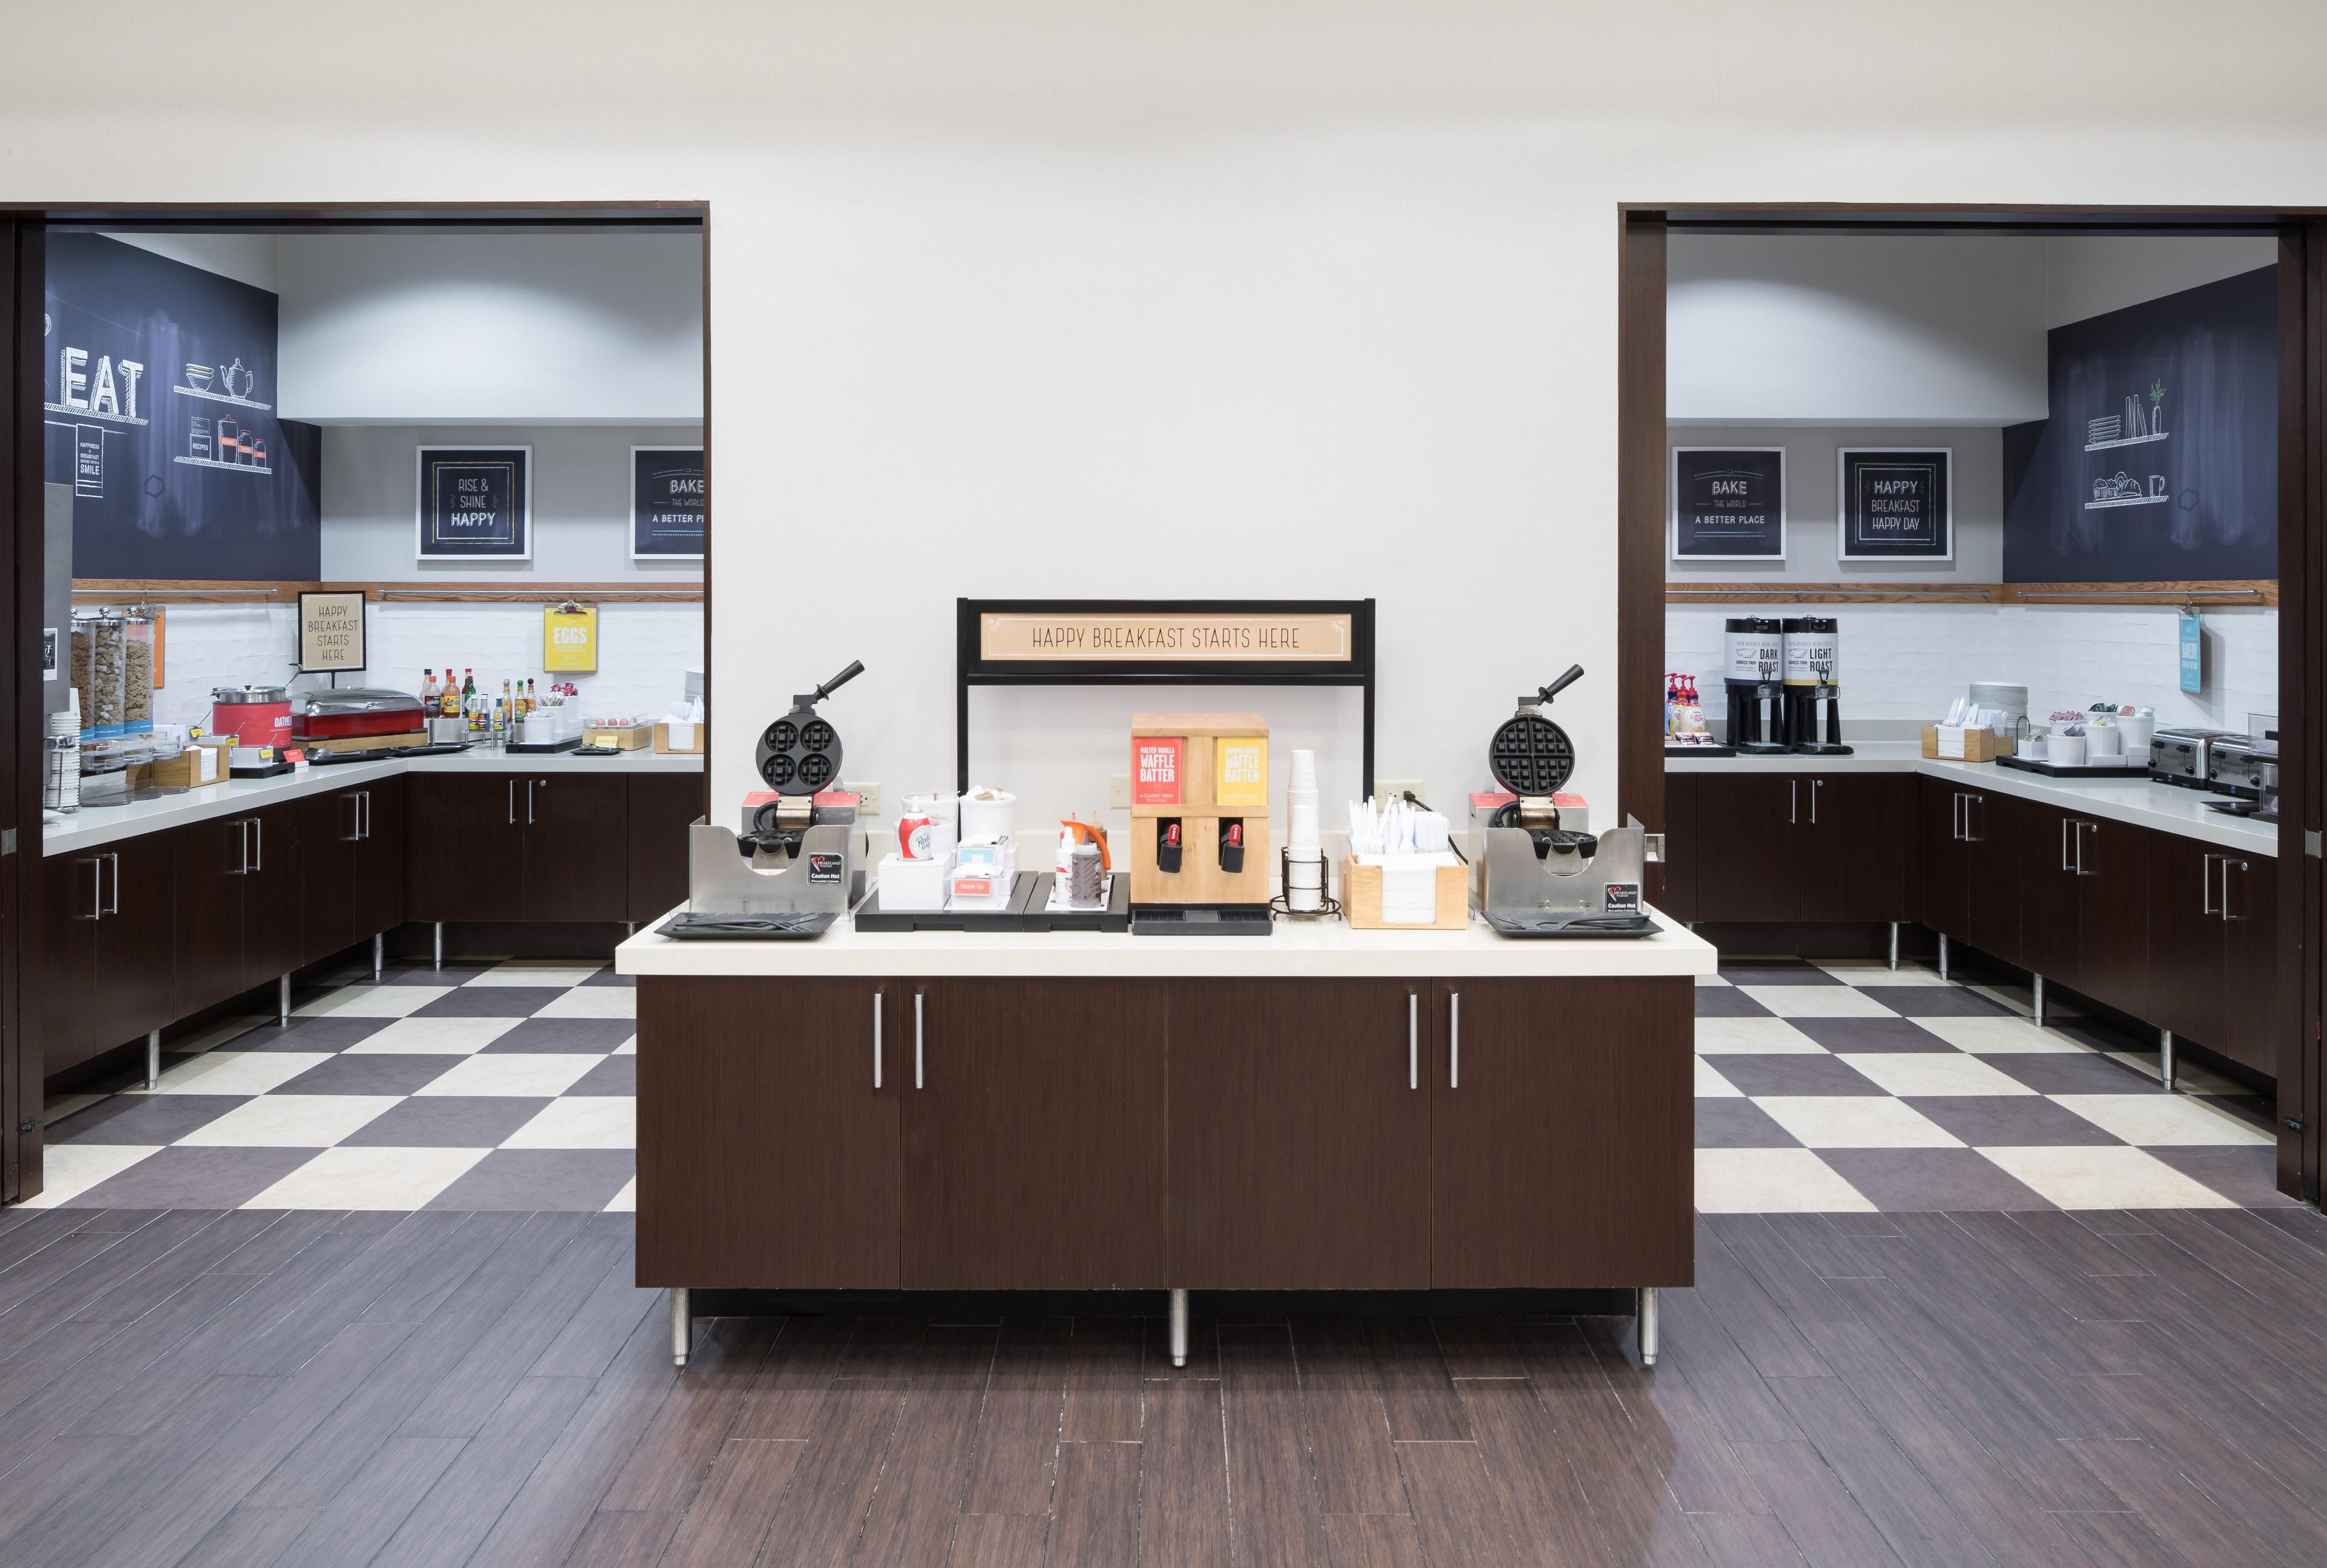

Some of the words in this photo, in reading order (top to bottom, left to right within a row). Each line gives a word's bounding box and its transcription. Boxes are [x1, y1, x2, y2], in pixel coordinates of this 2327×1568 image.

[61, 347, 144, 417] EAT
[80, 464, 99, 475] SMILE
[459, 479, 478, 491] RISE
[481, 479, 488, 491] &
[670, 479, 704, 494] BAKE
[1712, 480, 1747, 495] BAKE
[1874, 480, 1918, 494] HAPPY
[461, 496, 486, 508] SHINE
[1871, 499, 1920, 513] BREAKFAST
[451, 513, 496, 526] HAPPY
[1873, 517, 1901, 530] HAPPY
[1903, 517, 1920, 530] DAY
[319, 606, 347, 617] HAPPY
[308, 620, 358, 632] BREAKFAST
[318, 634, 349, 646] STARTS
[553, 626, 587, 644] EGGS
[1033, 627, 1085, 648] HAPPY
[1093, 627, 1185, 648] BREAKFAST
[1192, 627, 1251, 648] STARTS
[1259, 627, 1300, 648] HERE
[322, 649, 345, 660] HERE
[1760, 648, 1778, 660] DARK
[1809, 648, 1832, 659] LIGHT
[1759, 661, 1779, 673] ROAST
[1809, 660, 1833, 671] ROAST
[1140, 754, 1174, 768] WAFFLE
[1225, 754, 1260, 768] WAFFLE
[1140, 768, 1174, 782] BATTER
[1225, 769, 1259, 783] BATTER
